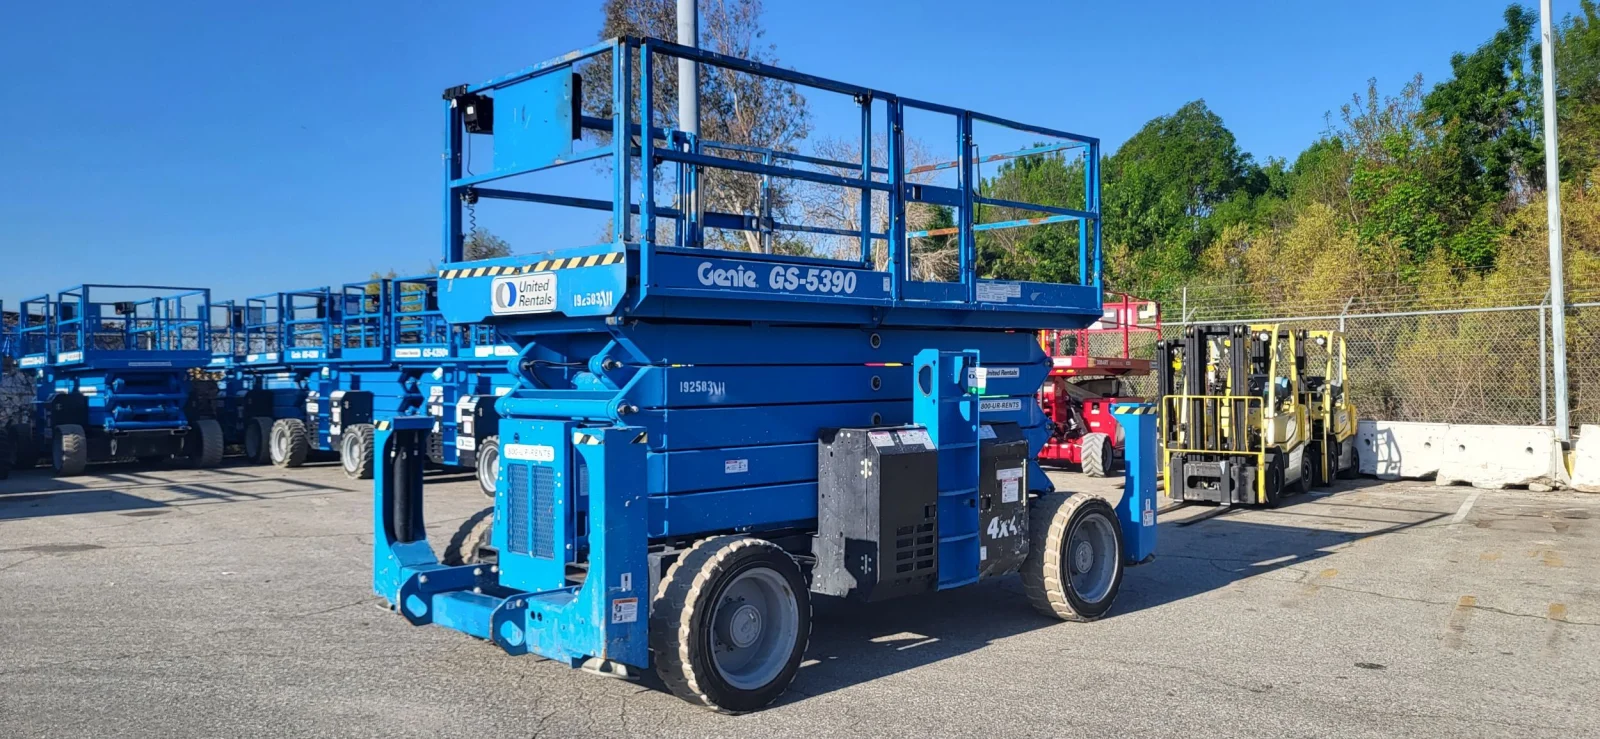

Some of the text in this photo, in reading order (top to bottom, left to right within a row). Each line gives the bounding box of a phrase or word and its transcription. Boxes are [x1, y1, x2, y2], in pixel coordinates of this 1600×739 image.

[698, 262, 757, 288] Genie
[769, 266, 857, 294] GS-5390
[519, 279, 549, 293] United
[519, 295, 552, 307] Rentals
[981, 401, 1019, 410] 800-UR-RENTS
[987, 515, 1018, 539] 4x4
